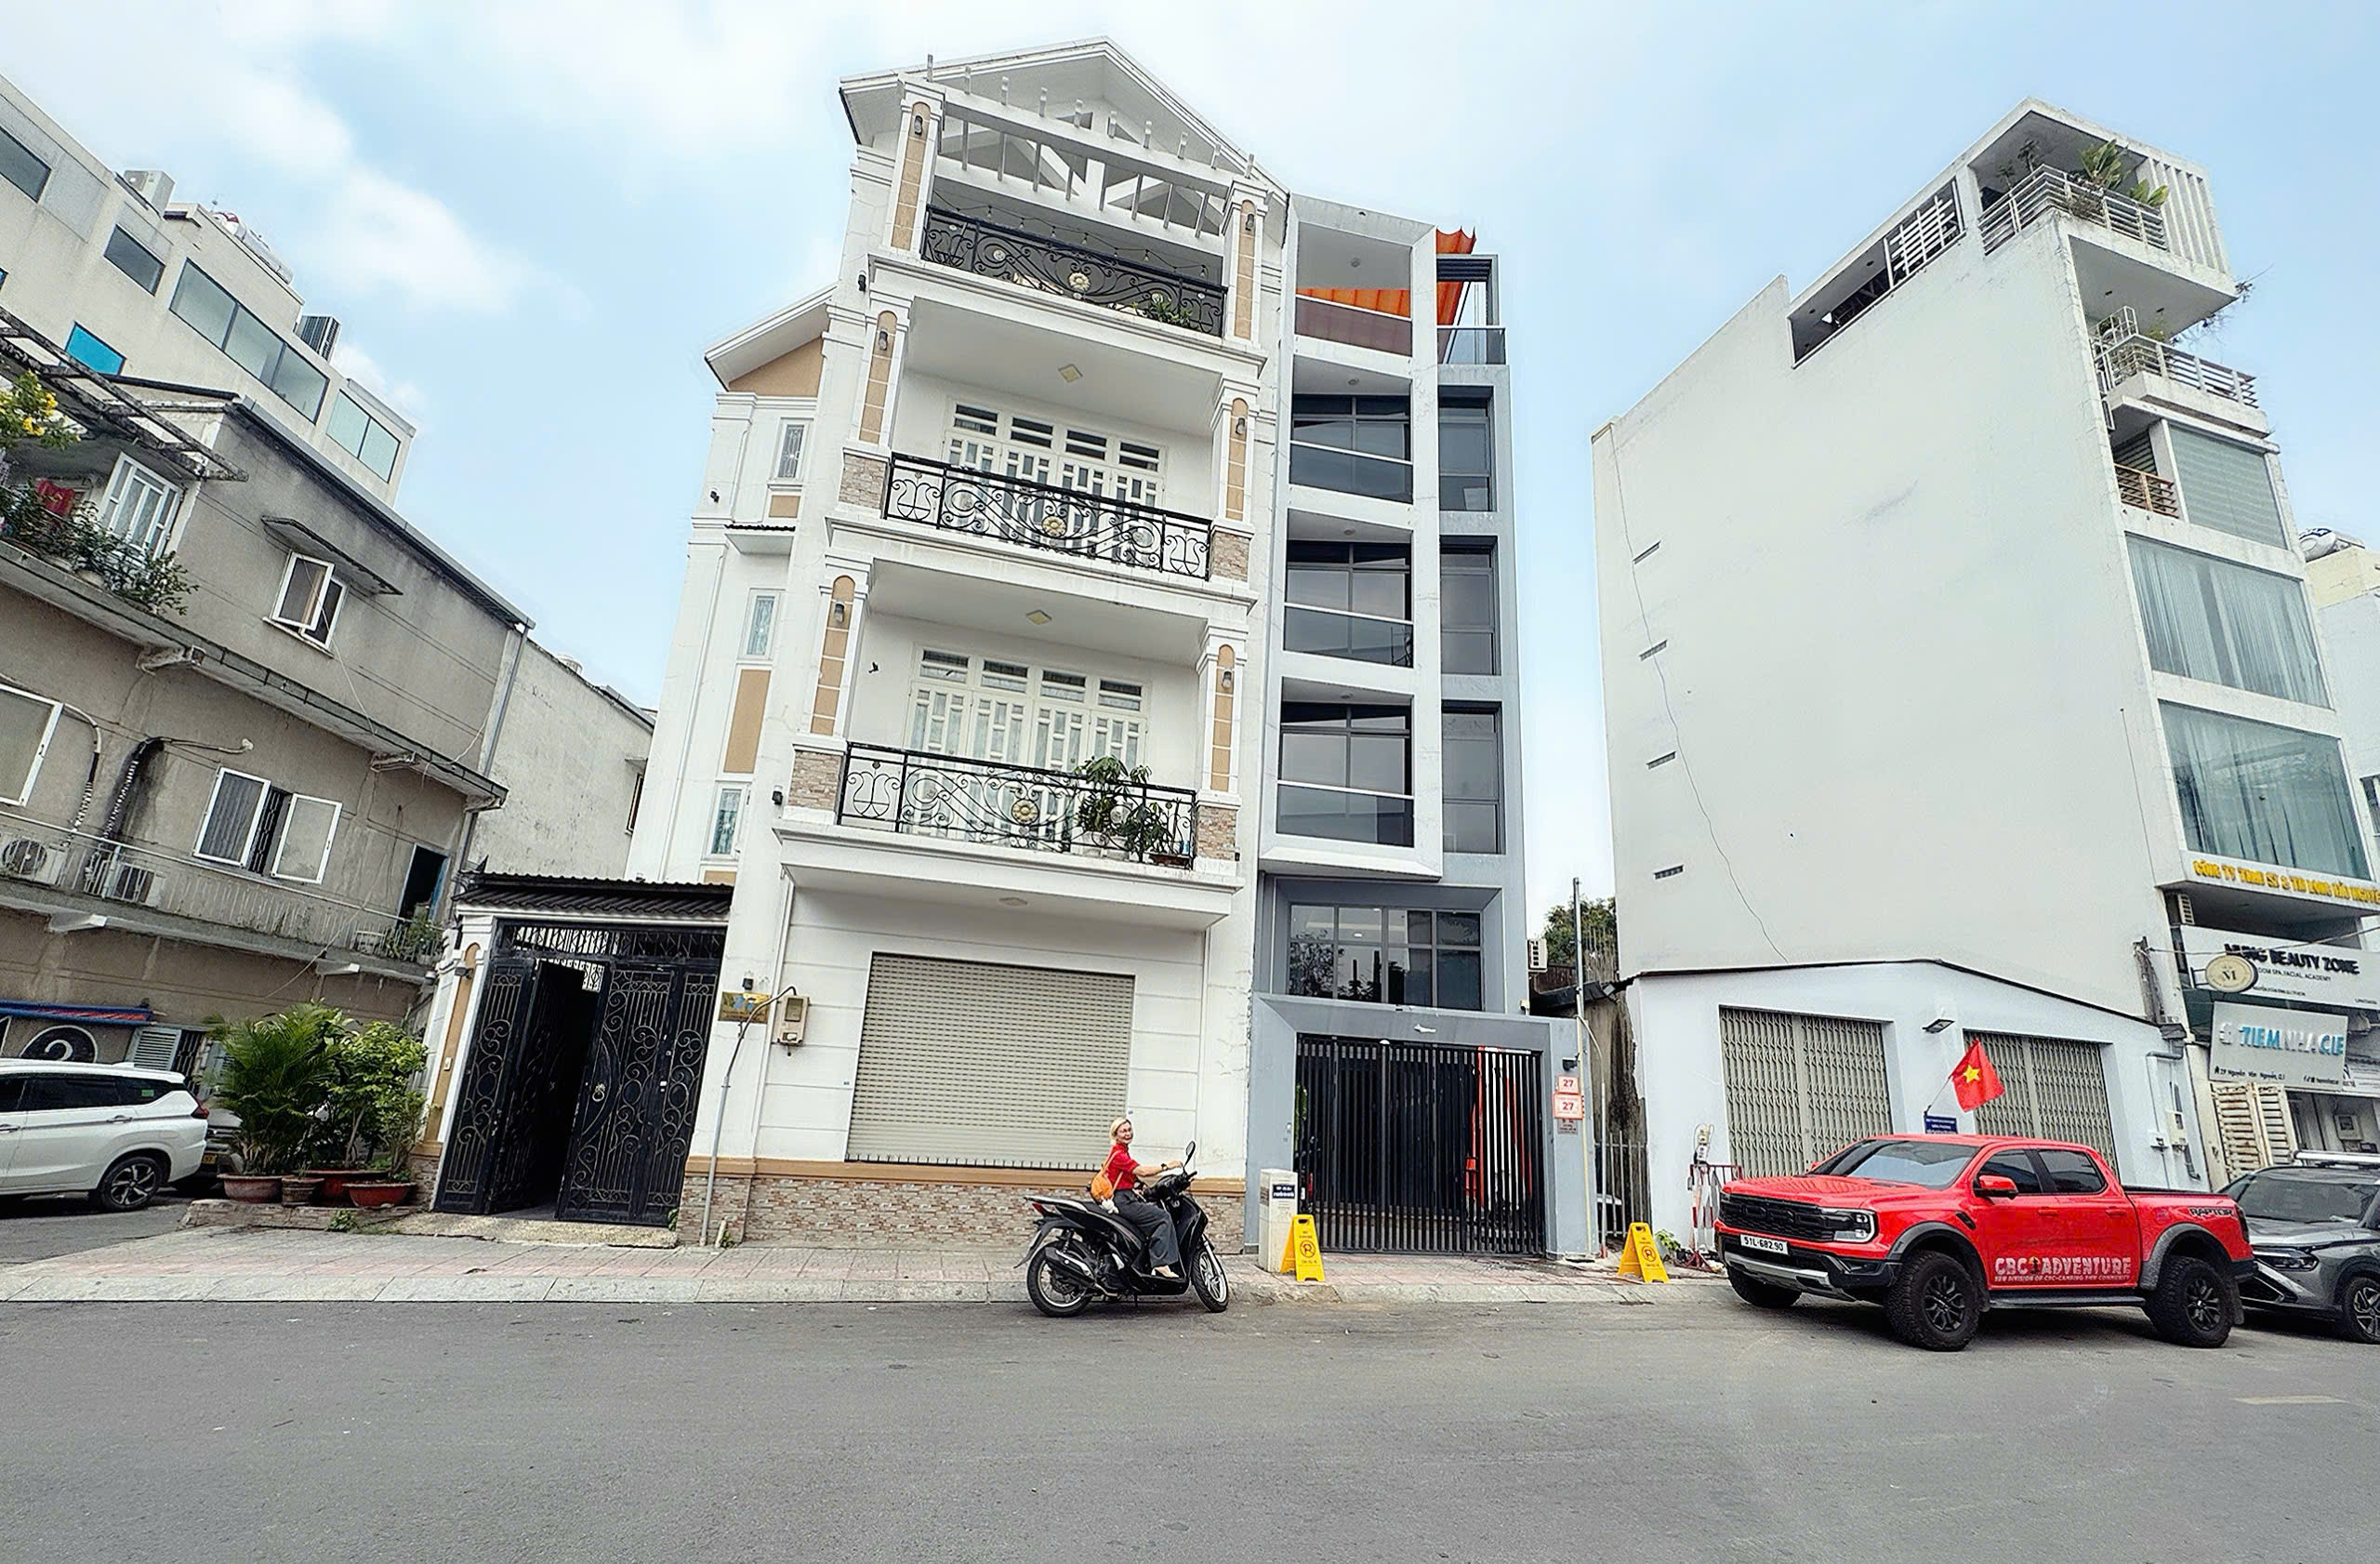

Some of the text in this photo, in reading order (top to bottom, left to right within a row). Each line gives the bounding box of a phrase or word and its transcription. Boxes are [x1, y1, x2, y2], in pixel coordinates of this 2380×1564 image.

[2269, 948, 2320, 970] BEAUTY
[2321, 957, 2360, 975] ZONE
[1563, 1079, 1574, 1087] 27
[1562, 1101, 1574, 1111] 27
[2188, 1207, 2235, 1218] RAPTOR
[1994, 1256, 2132, 1276] CBC ADVENTURE
